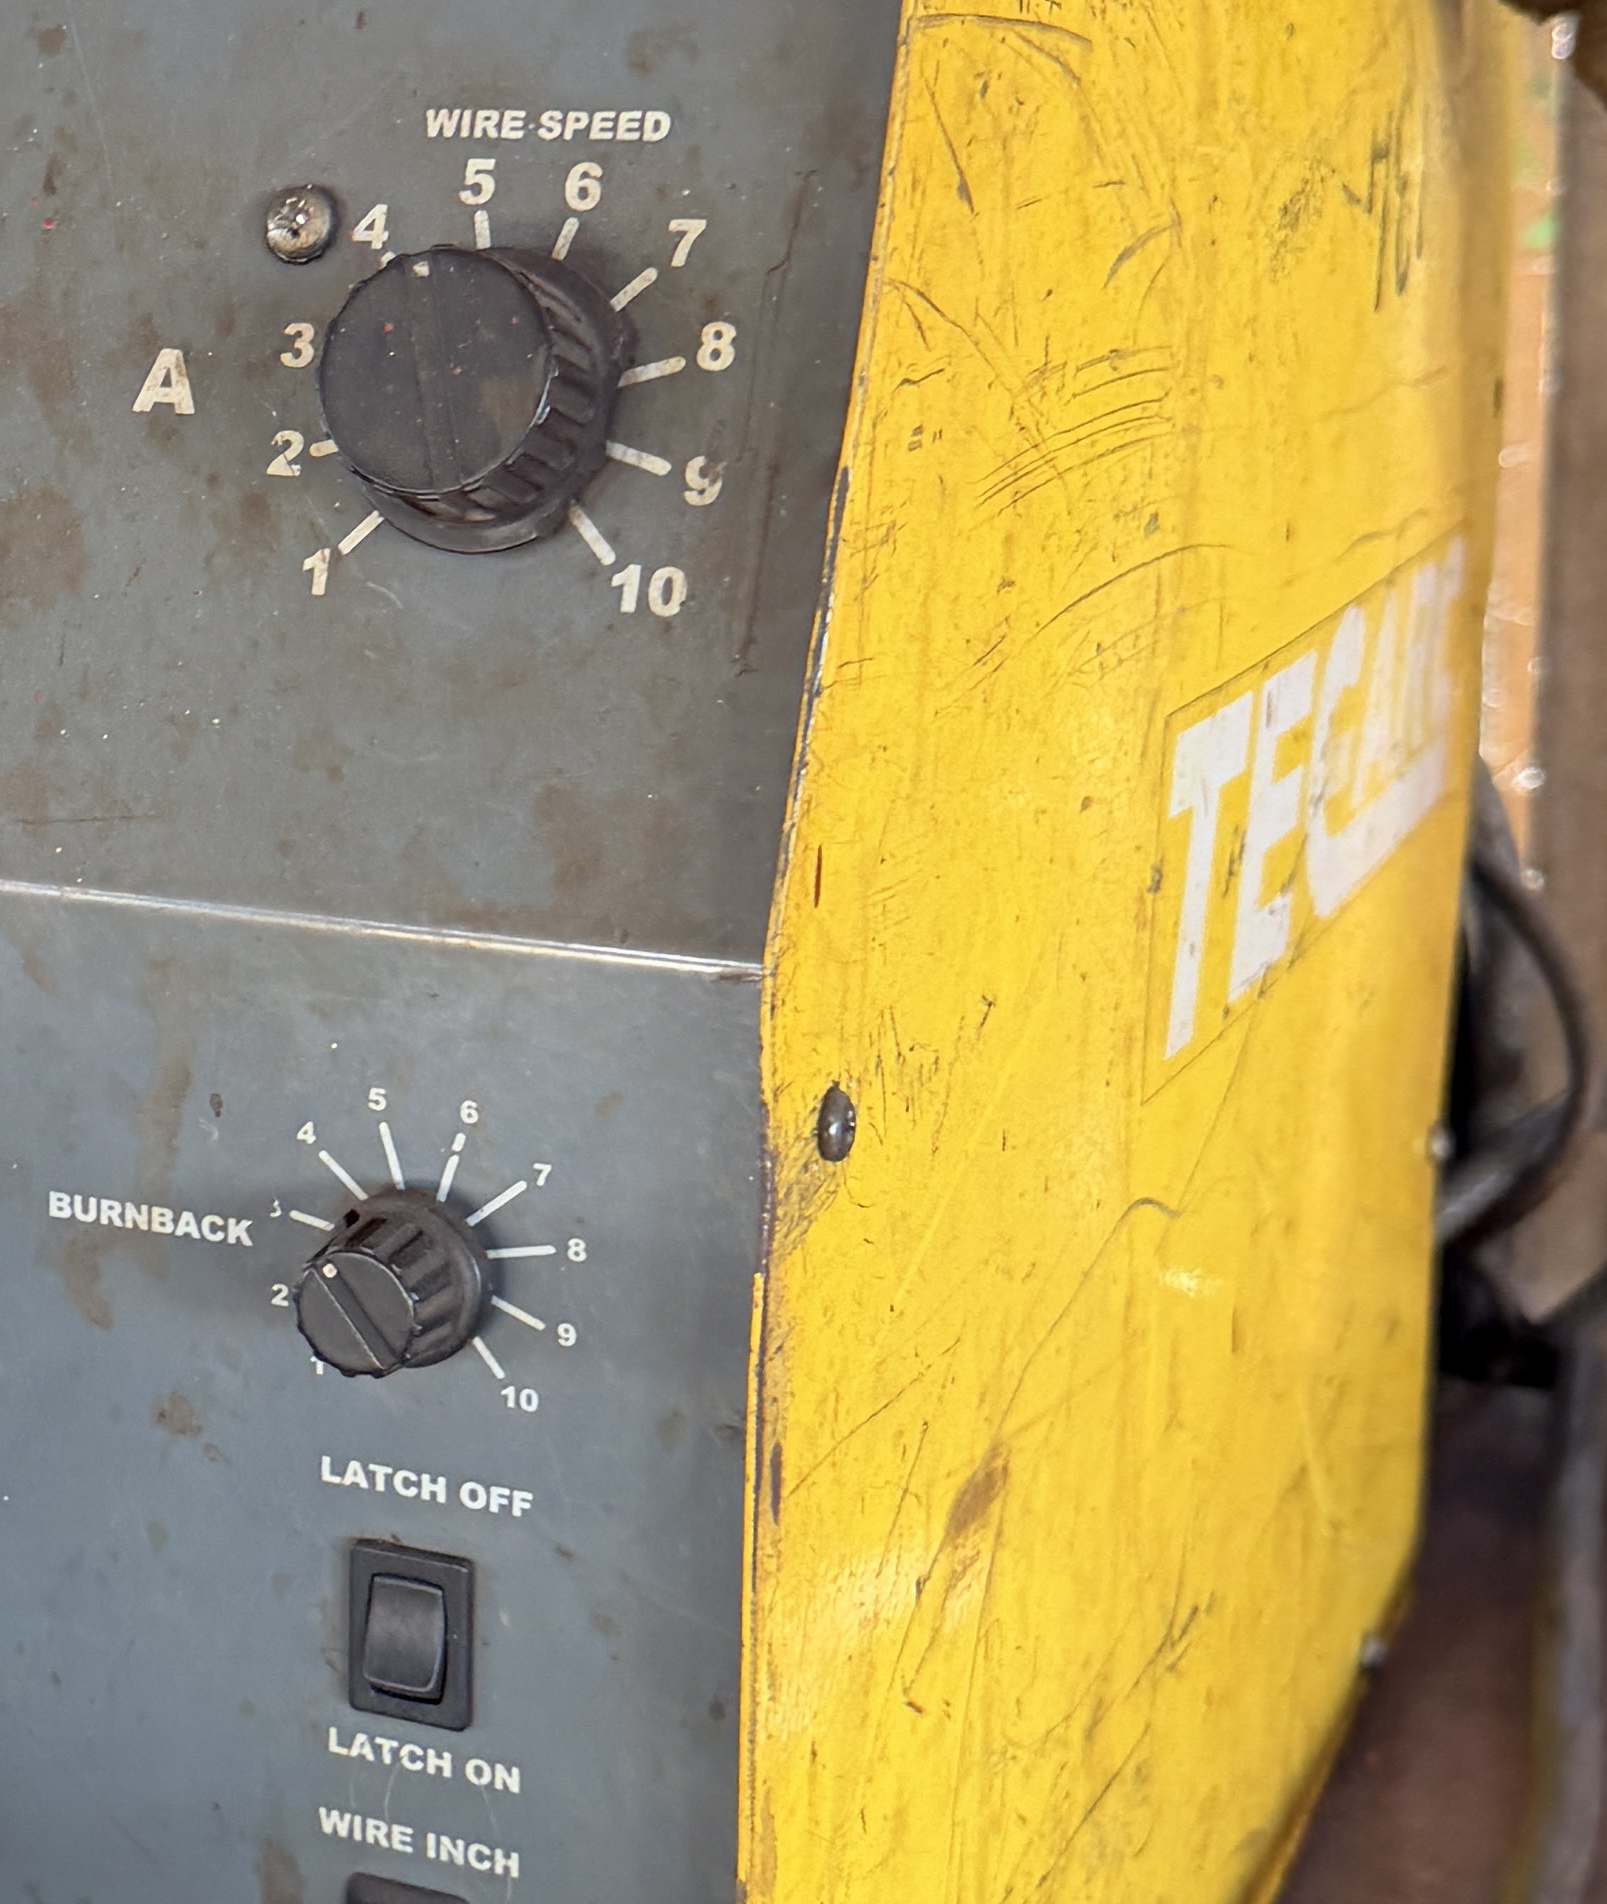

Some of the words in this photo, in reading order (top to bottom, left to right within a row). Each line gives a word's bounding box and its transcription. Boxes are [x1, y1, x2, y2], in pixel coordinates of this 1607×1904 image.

[425, 108, 527, 139] WIRE
[536, 109, 672, 142] SPEED
[458, 157, 496, 206] 5
[564, 161, 603, 211] 6
[351, 204, 389, 250] 4
[667, 219, 707, 267] 7
[279, 322, 315, 368] 3
[695, 321, 737, 372] 8
[131, 347, 196, 416] A
[266, 430, 305, 477] 2
[682, 455, 724, 506] 9
[301, 548, 331, 596] 1
[610, 563, 688, 617] 10
[367, 1087, 387, 1112] 5
[459, 1100, 479, 1125] 6
[295, 1121, 317, 1145] 4
[532, 1163, 553, 1187] 7
[47, 1191, 254, 1247] BURNBACK
[566, 1238, 588, 1262] 8
[270, 1283, 290, 1307] 2
[556, 1323, 578, 1348] 9
[500, 1386, 540, 1413] 10
[320, 1455, 447, 1504] LATCH
[458, 1481, 534, 1518] OFF
[327, 1726, 453, 1779] LATCH
[465, 1758, 521, 1795] ON
[318, 1806, 414, 1855] WIRE
[426, 1832, 520, 1879] INCH
